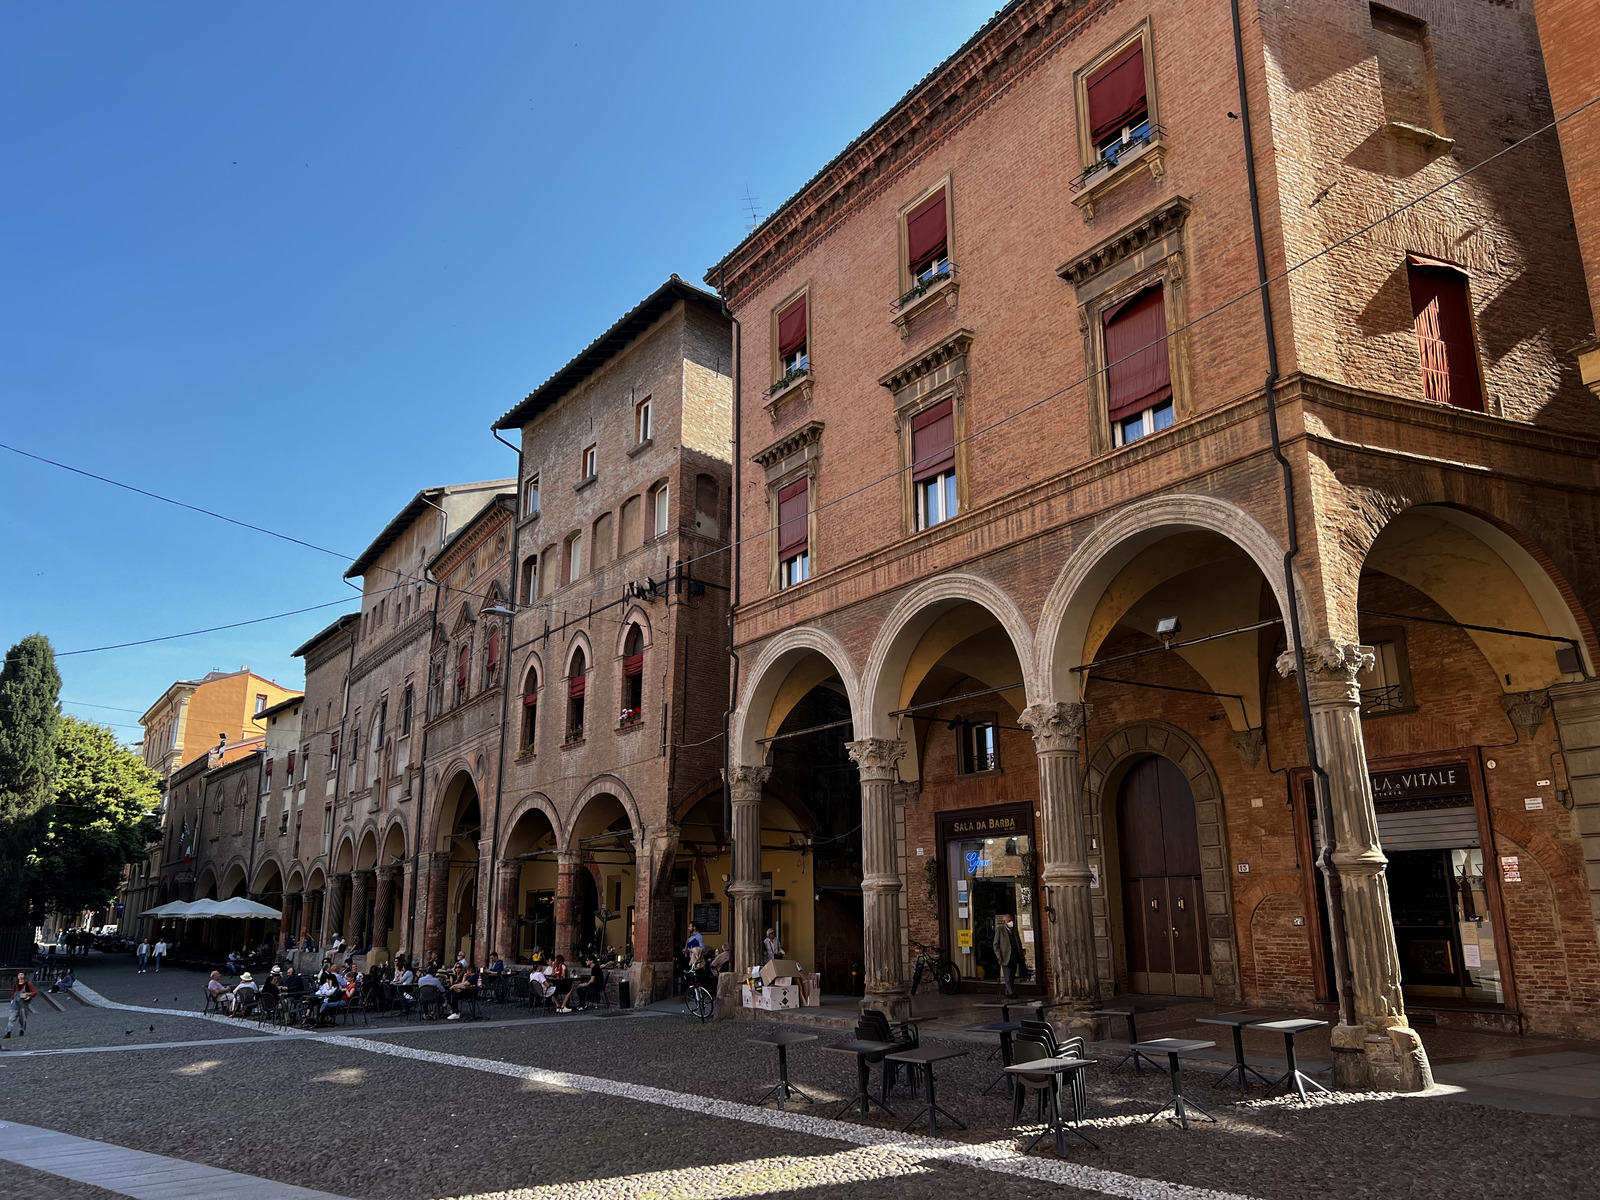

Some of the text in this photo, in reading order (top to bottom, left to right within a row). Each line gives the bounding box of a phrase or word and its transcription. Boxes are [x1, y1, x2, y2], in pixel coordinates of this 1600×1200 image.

[1402, 770, 1456, 788] VITALE
[954, 818, 1015, 832] SALA DA BARBA
